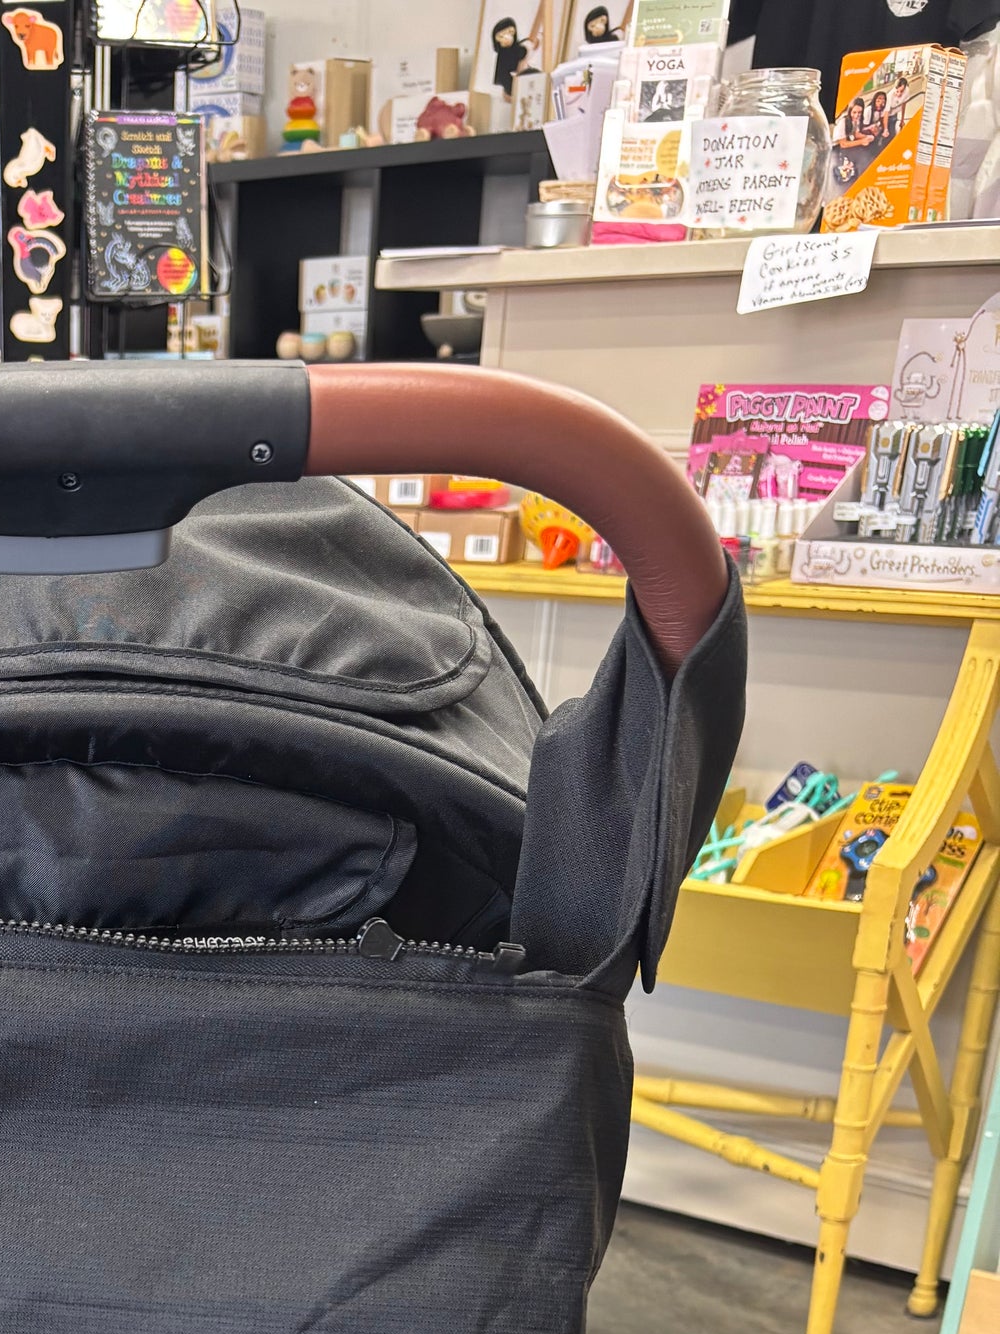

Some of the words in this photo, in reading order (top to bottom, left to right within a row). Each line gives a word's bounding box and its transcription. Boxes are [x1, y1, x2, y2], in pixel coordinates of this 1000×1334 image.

[646, 59, 685, 71] YOGA
[703, 133, 778, 153] DONATION
[111, 153, 169, 171] Dragons
[171, 155, 183, 169] &
[715, 154, 744, 169] JAR
[113, 170, 180, 189] Mythical
[743, 174, 797, 190] PARENT
[113, 189, 183, 206] Creatures
[728, 392, 791, 420] PIGGY
[790, 393, 858, 422] PAINT
[780, 434, 809, 446] Polish
[869, 551, 909, 572] Great
[910, 555, 977, 577] Pretenders
